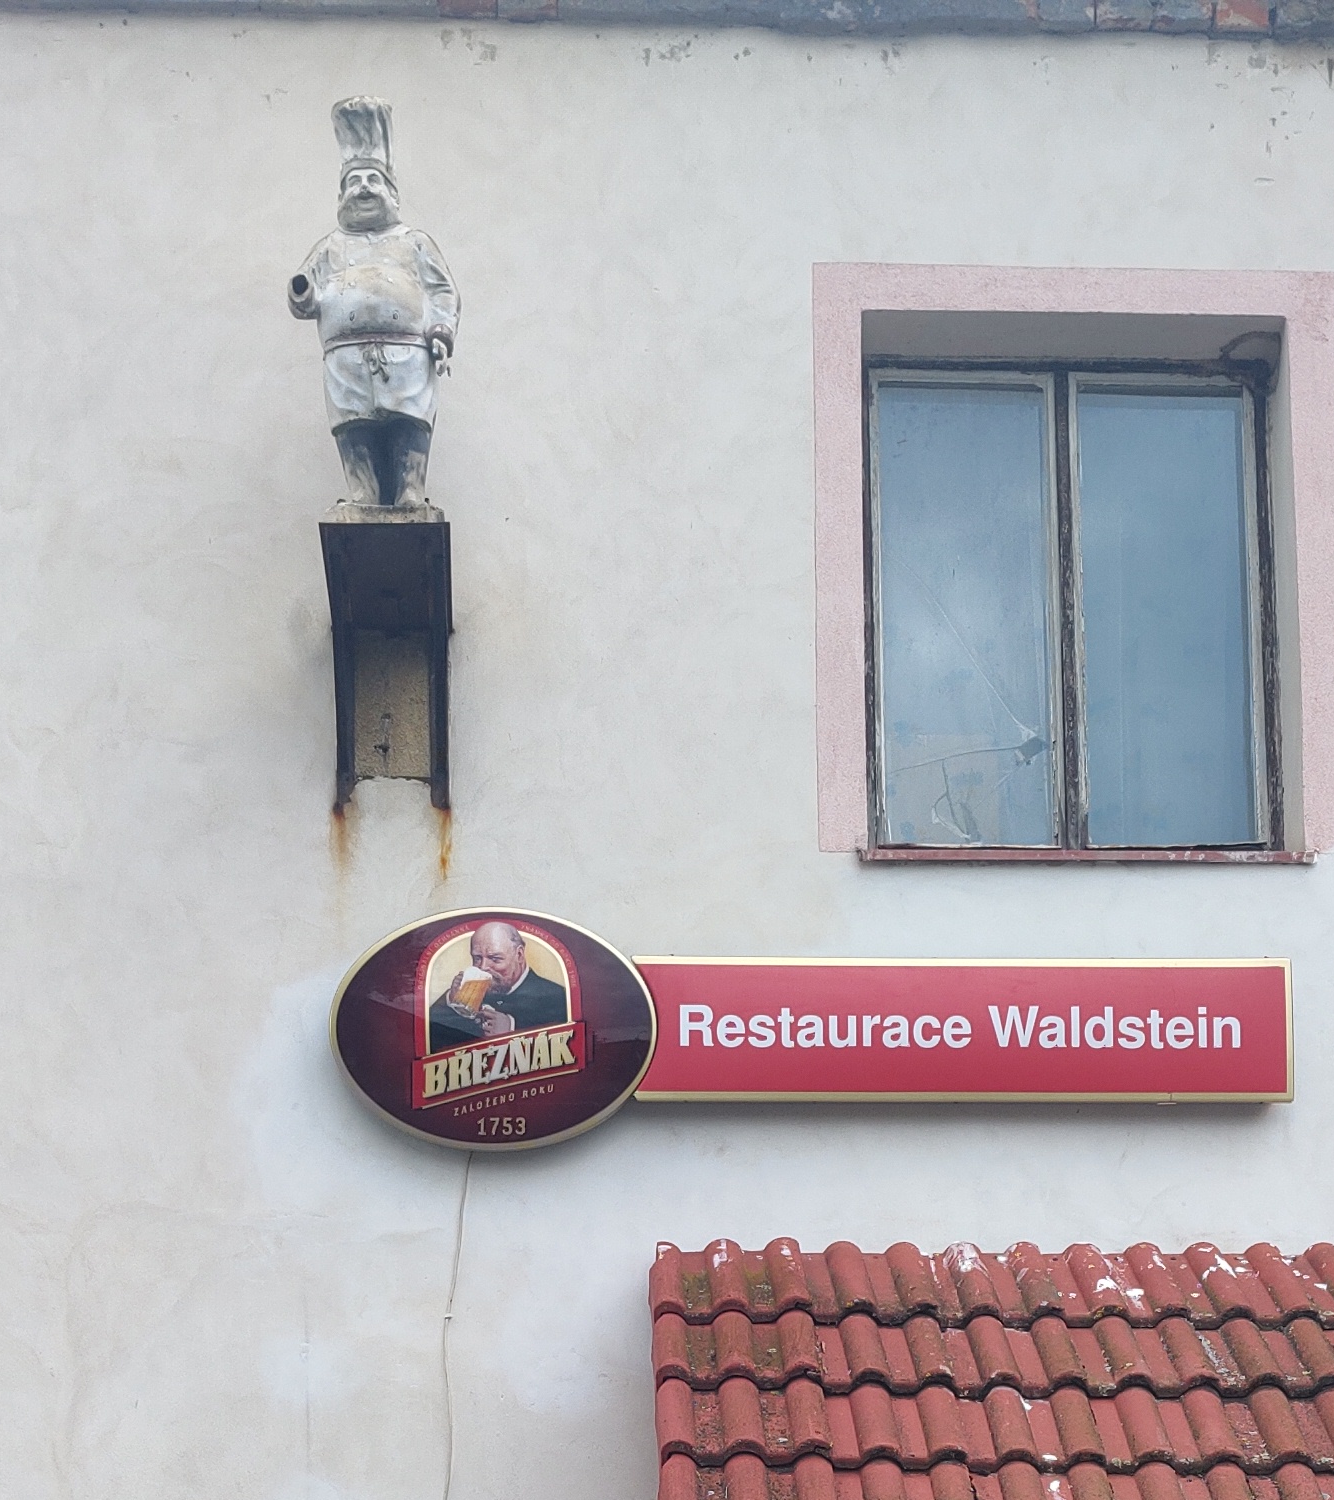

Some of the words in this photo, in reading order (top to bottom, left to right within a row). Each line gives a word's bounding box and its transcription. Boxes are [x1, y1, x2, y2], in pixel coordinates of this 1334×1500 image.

[679, 1004, 972, 1048] Restaurace
[987, 1005, 1242, 1049] Waldstein
[422, 1030, 576, 1099] BŘEZŇÁK
[453, 1093, 516, 1117] ZALOŽENO
[522, 1083, 555, 1099] ROKU
[477, 1116, 527, 1136] 1753
